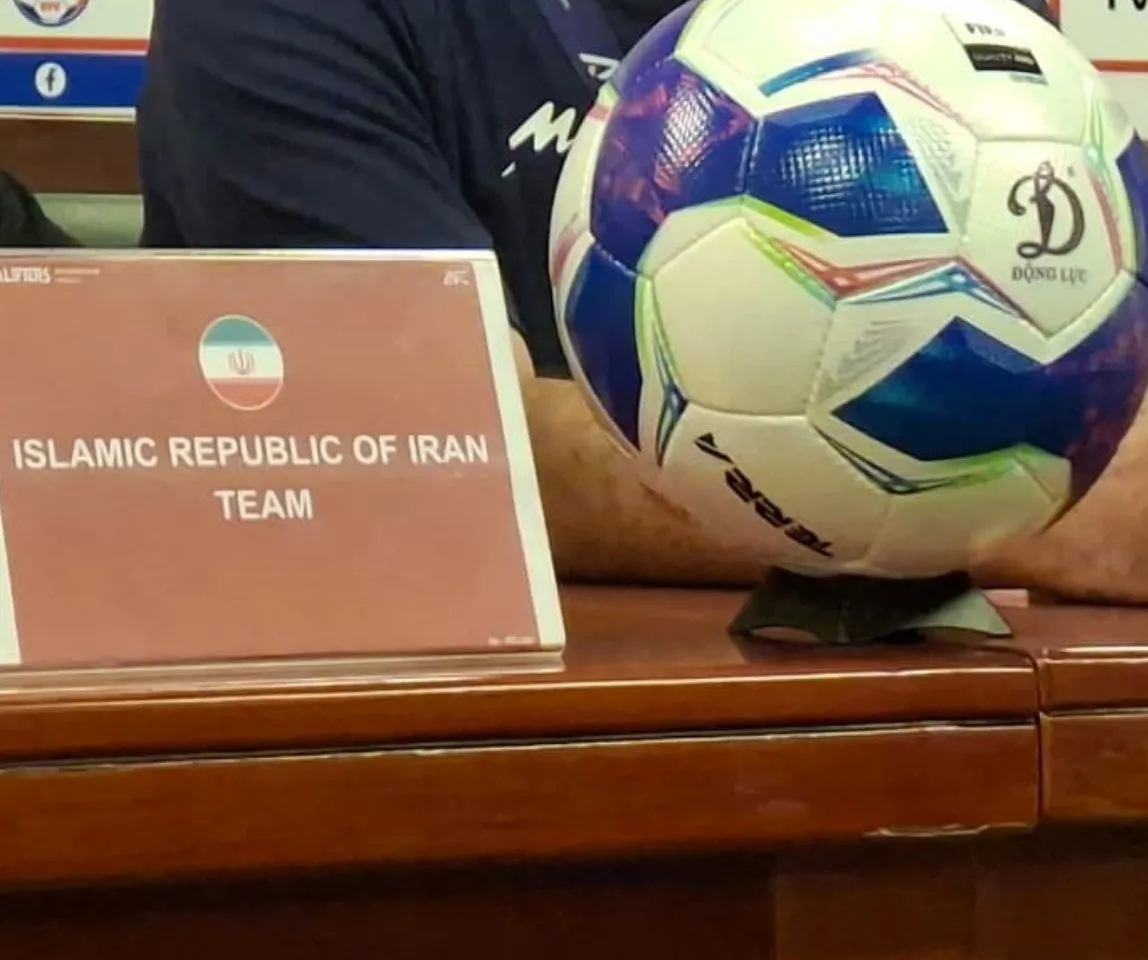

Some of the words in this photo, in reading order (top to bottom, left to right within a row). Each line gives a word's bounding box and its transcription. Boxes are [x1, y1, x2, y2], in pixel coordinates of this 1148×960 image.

[13, 436, 159, 469] ISLAMIC
[168, 435, 343, 467] REPUBLIC
[352, 435, 397, 464] OF
[408, 434, 490, 464] IRAN
[214, 489, 314, 520] TEAM
